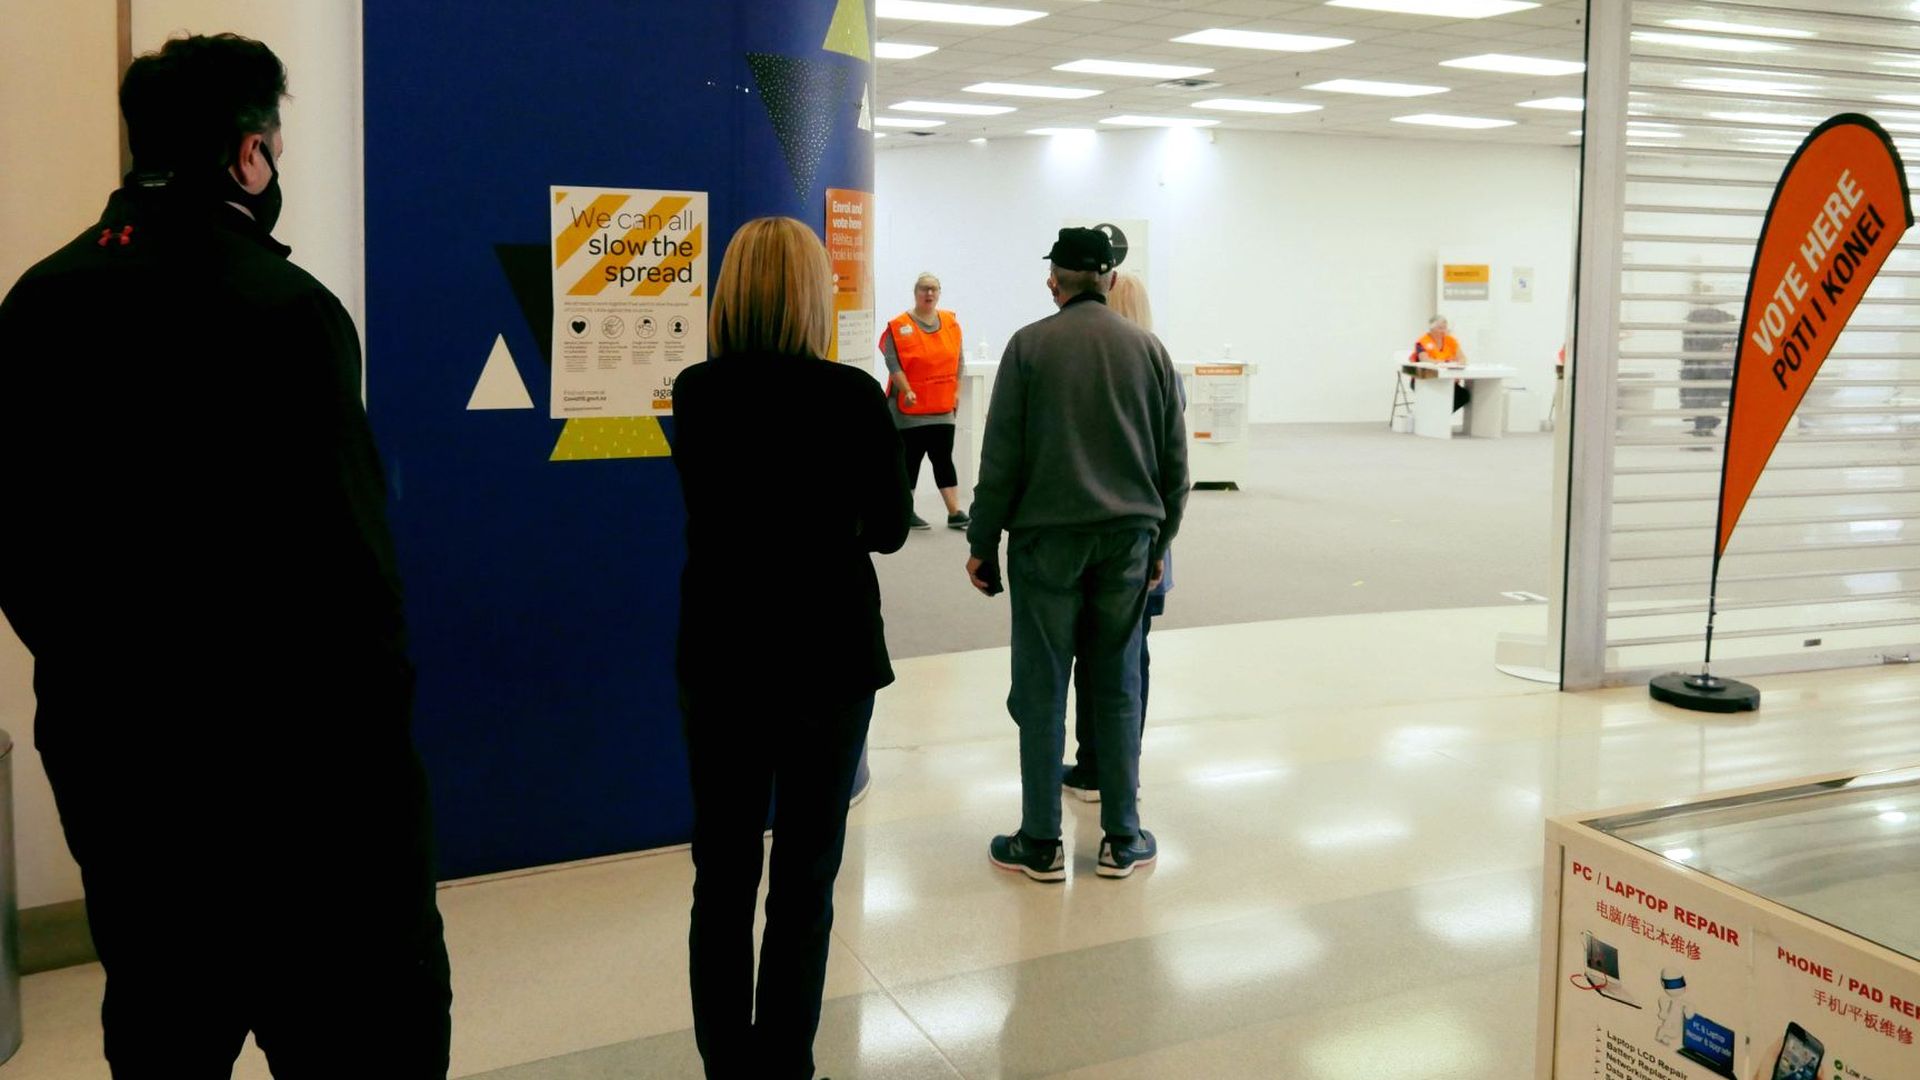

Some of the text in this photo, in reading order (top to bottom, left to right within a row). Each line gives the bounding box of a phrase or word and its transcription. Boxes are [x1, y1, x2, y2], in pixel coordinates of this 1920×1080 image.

[571, 206, 692, 231] We can all
[588, 233, 693, 257] slow the
[1751, 168, 1864, 356] VOTE HERE
[1811, 297, 1828, 322] I
[1820, 203, 1886, 305] KONEI
[605, 261, 692, 288] spread
[1572, 861, 1740, 947] PC / LAPTOP REPAIR
[1596, 900, 1702, 960] 电脑/笔记本维修
[1777, 946, 1833, 983] PHONE
[1838, 974, 1843, 986] /
[1848, 977, 1883, 1003] PAD
[1606, 1041, 1671, 1080] Battery Replac
[1606, 1063, 1624, 1079] Data
[1607, 1030, 1688, 1080] Laptop LCD Repair
